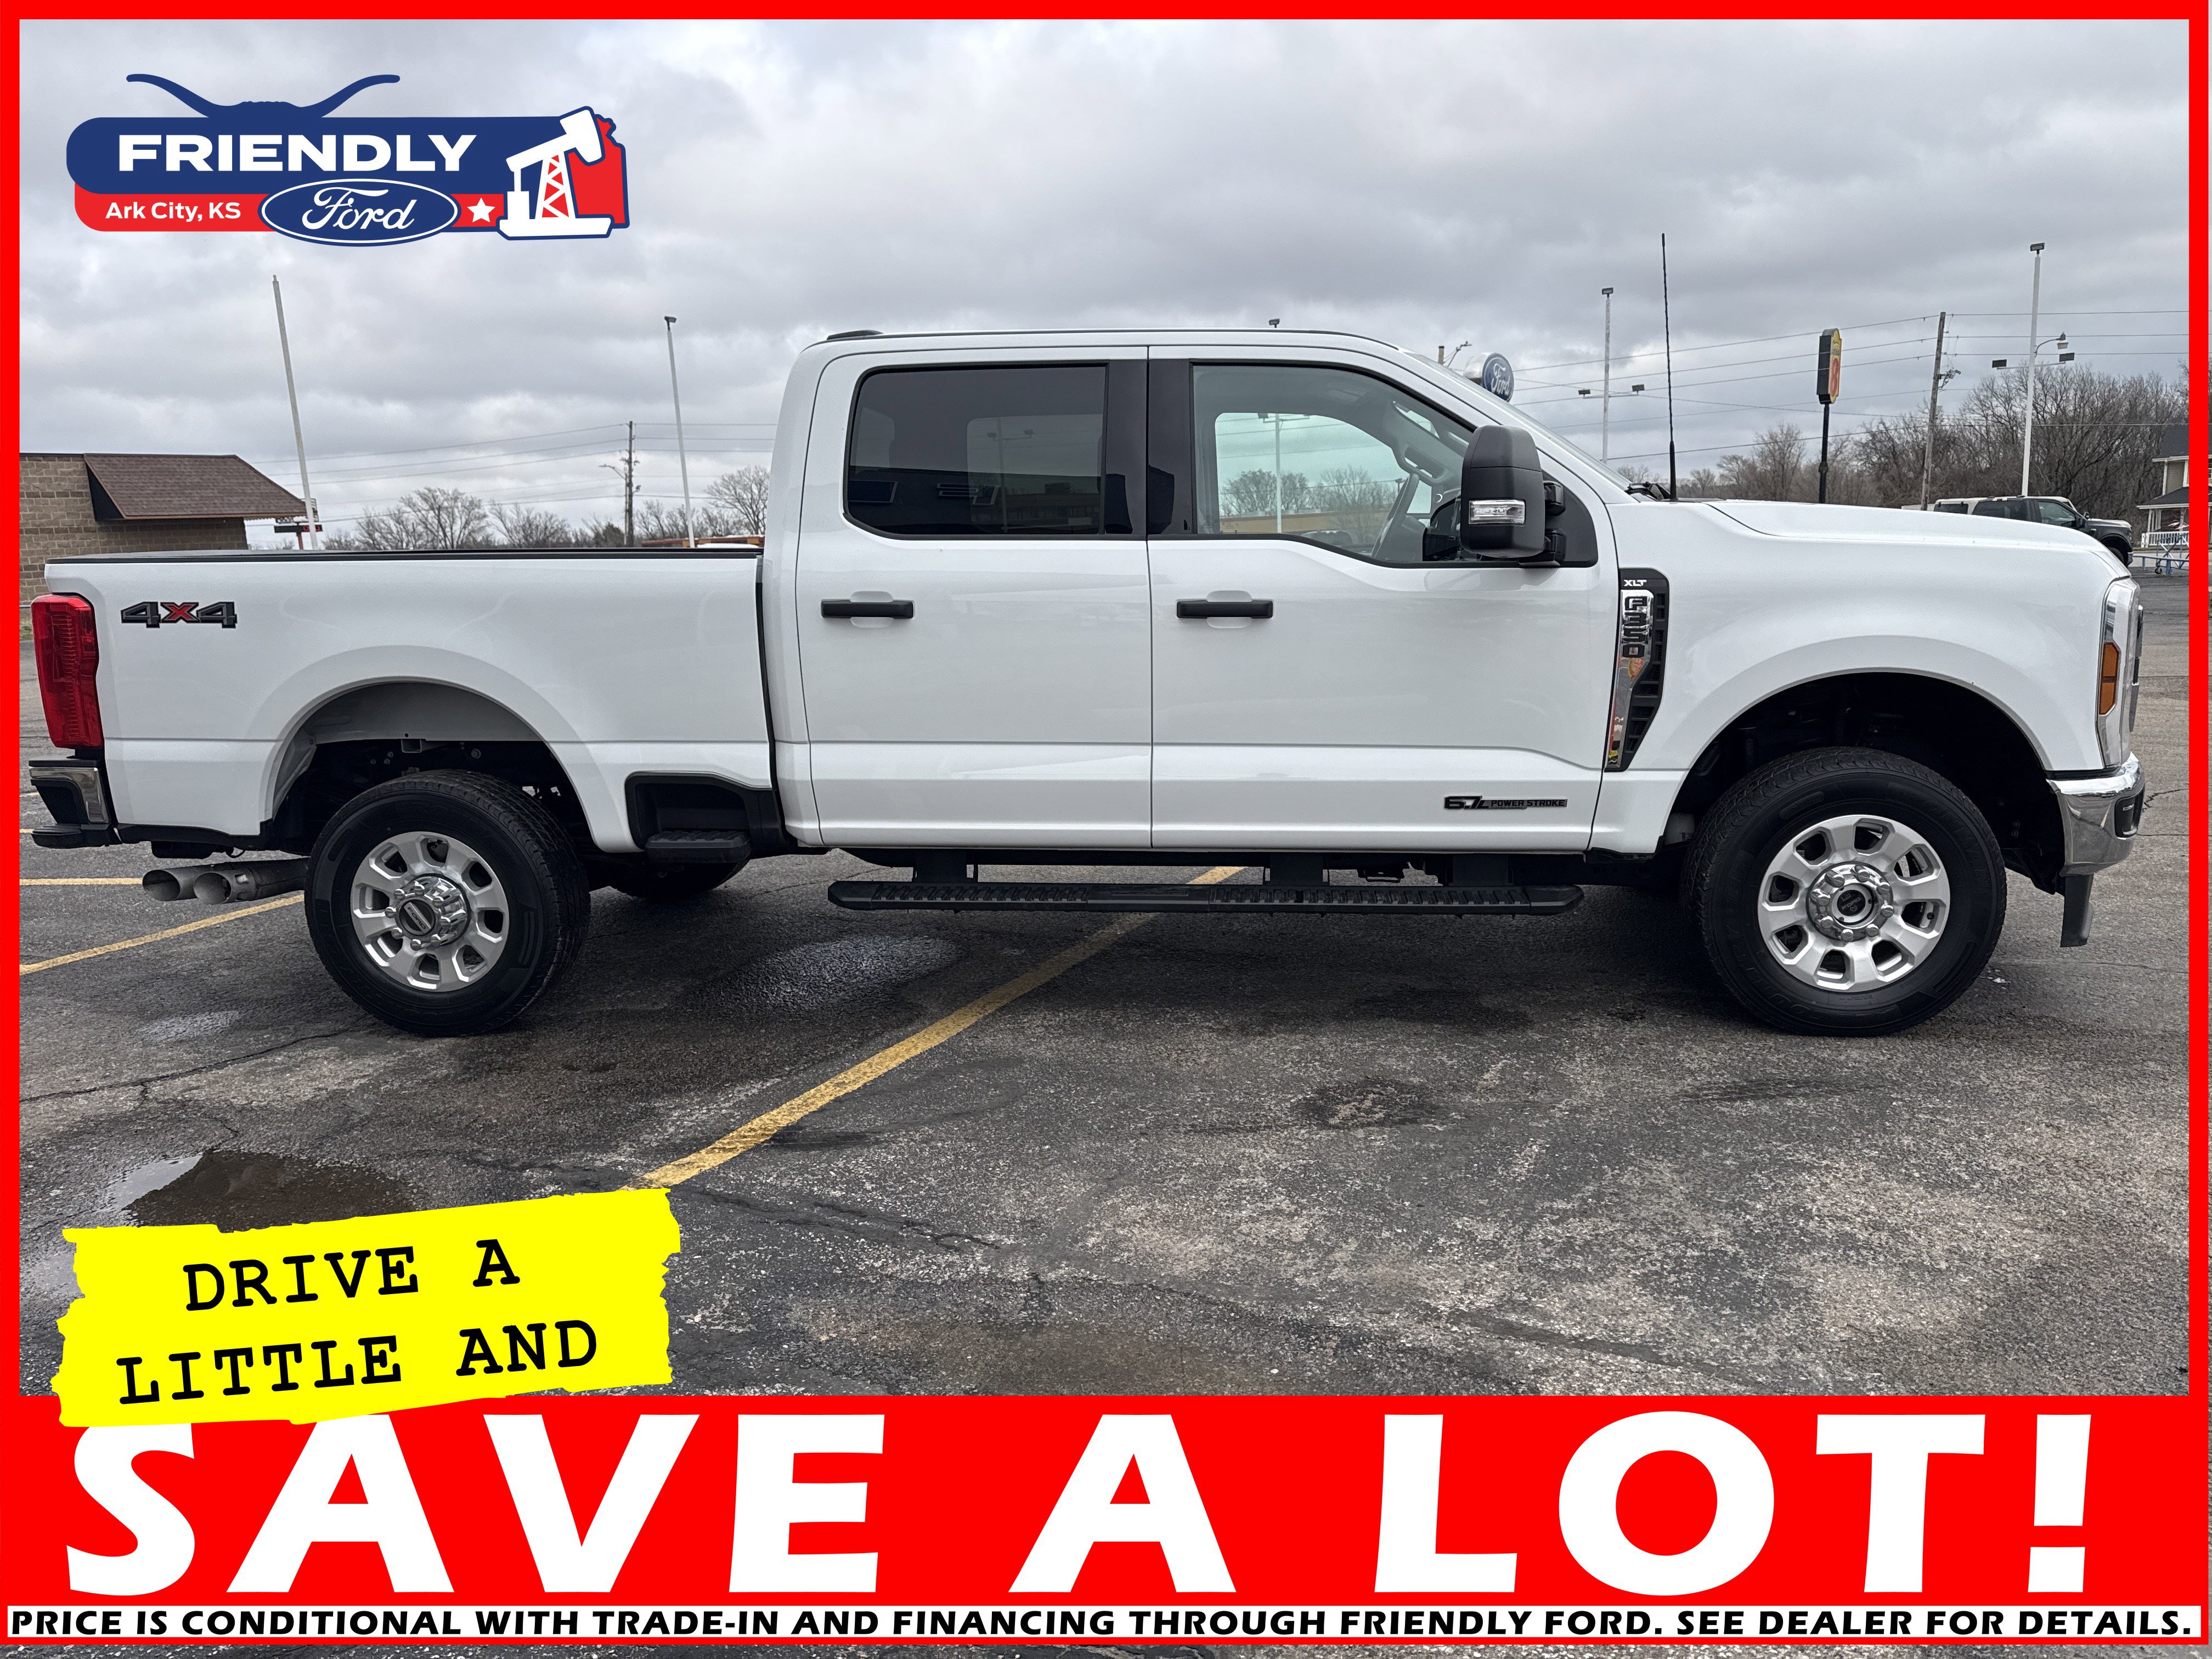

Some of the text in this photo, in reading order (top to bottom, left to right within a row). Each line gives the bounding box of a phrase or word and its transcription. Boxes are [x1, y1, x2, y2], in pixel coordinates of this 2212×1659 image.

[1491, 363, 1511, 396] Ford
[1444, 795, 1489, 809] 6.7L
[408, 907, 426, 929] FORD
